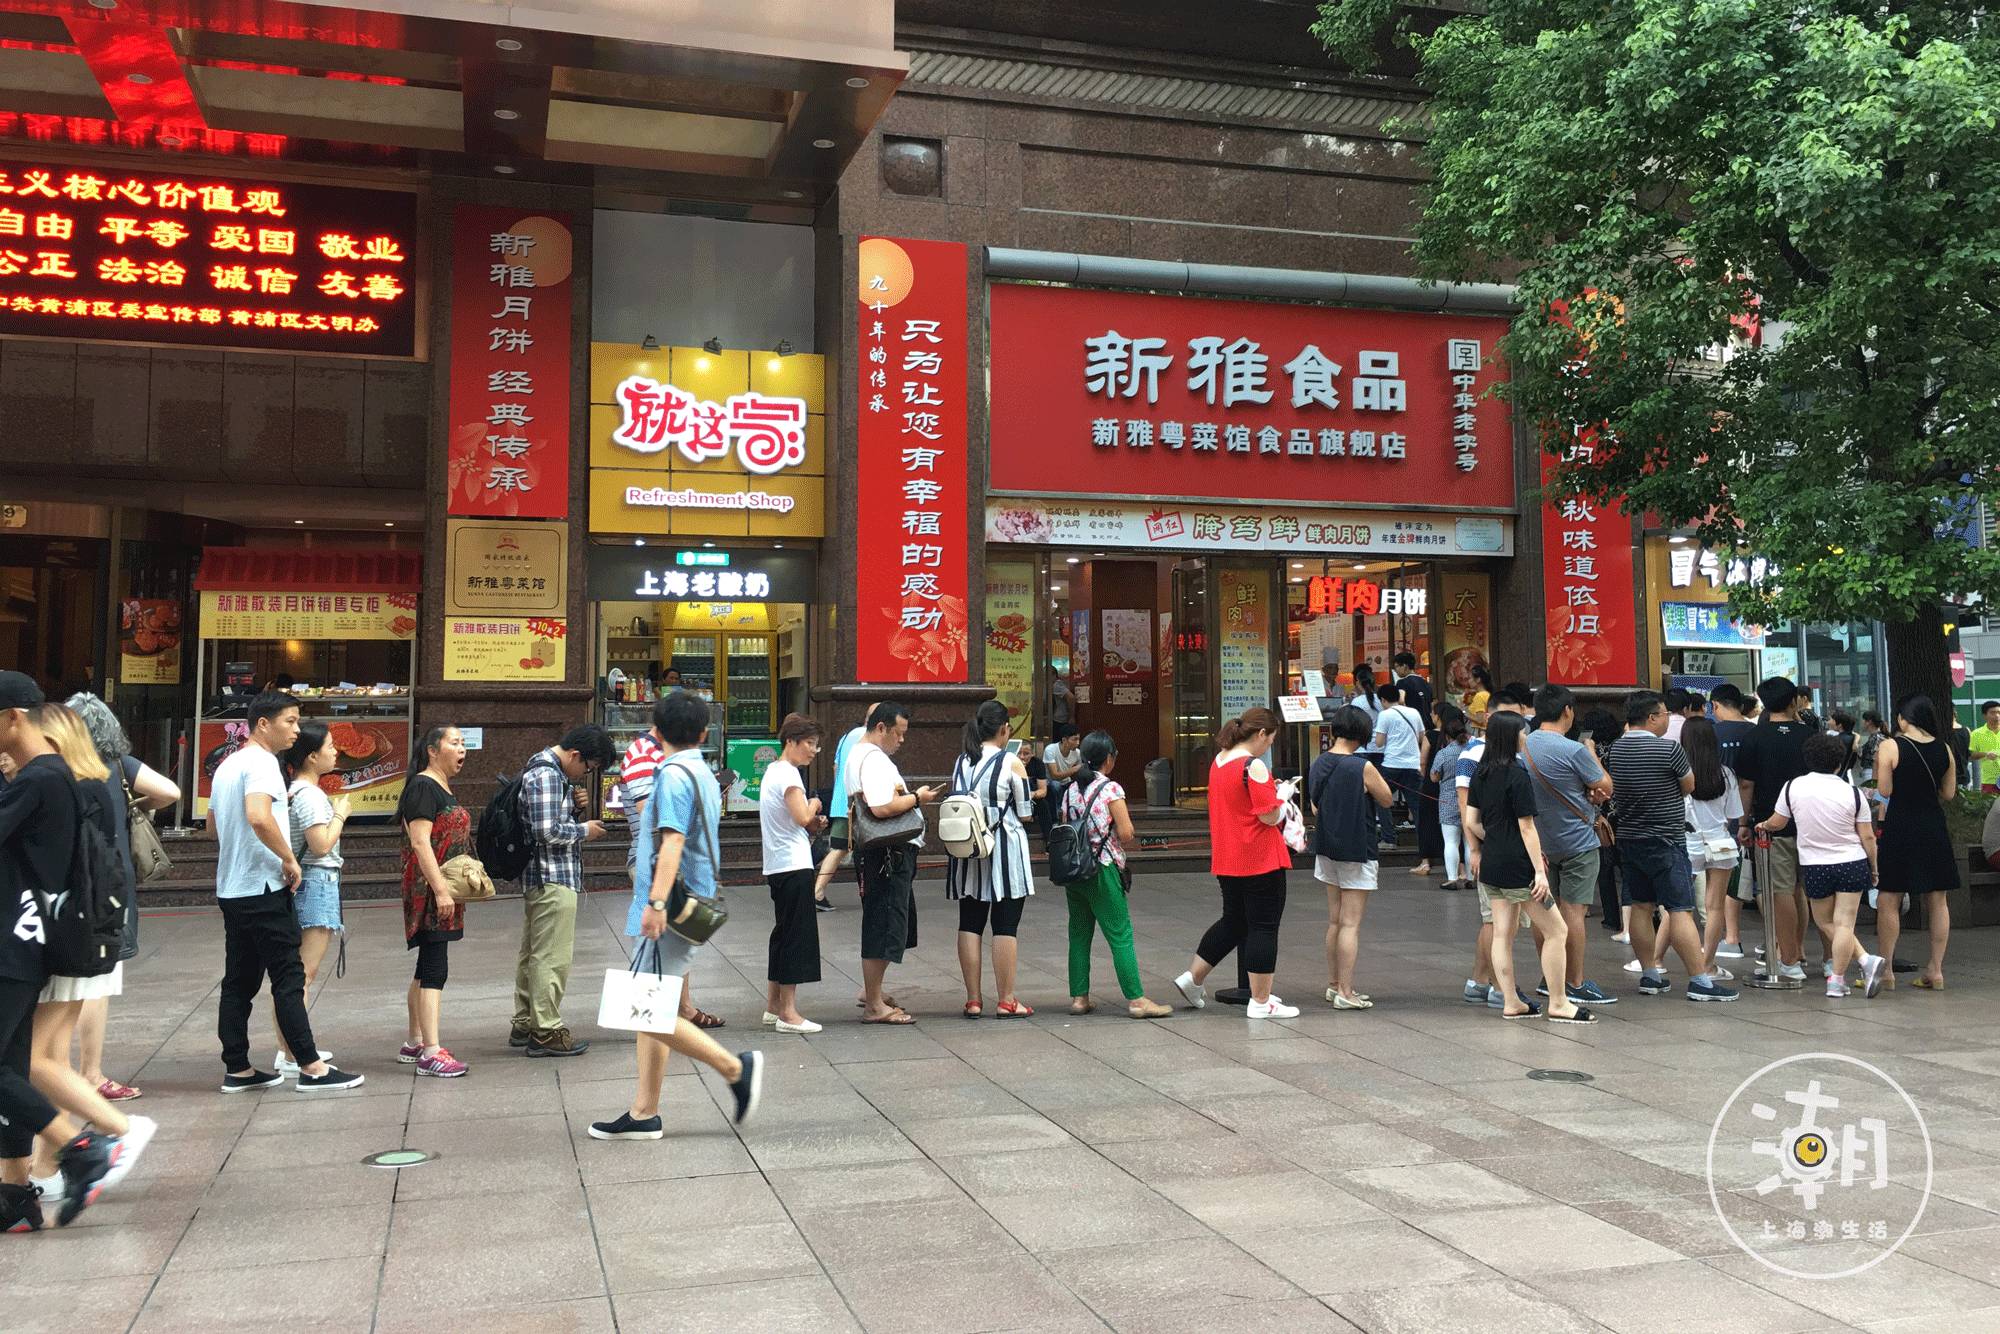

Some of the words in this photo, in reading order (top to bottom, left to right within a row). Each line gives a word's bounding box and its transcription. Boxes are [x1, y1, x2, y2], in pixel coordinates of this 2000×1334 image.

[0, 208, 74, 240] 自由
[99, 217, 190, 247] 平等
[209, 225, 296, 256] 爱国
[318, 233, 405, 263] 敬业
[0, 250, 78, 278] 公正
[98, 258, 186, 285] 法治
[209, 264, 298, 295] 诚信
[317, 270, 404, 301] 友善
[489, 232, 537, 355] 新雅月饼
[228, 309, 380, 333] 黄浦区文明办
[868, 274, 890, 413] 九十年的传承
[1084, 329, 1408, 412] 新雅食品
[485, 369, 535, 492] 经典传承
[1091, 417, 1408, 460] 新雅粤菜馆食品旗舰店
[1452, 373, 1480, 472] 中华老字号
[900, 319, 944, 632] 只为让您有幸福的感动
[629, 488, 744, 507] Refreshment
[749, 494, 793, 512] Shop
[1151, 520, 1179, 534] 网红
[1193, 513, 1300, 543] 腌笃鲜
[1306, 525, 1371, 545] 鲜肉月饼
[217, 594, 380, 613] 新雅散装月饼销售专柜
[467, 576, 546, 591] 新雅粤菜馆
[635, 570, 770, 597] 上海老酸奶
[1308, 575, 1427, 615] 鲜肉月饼
